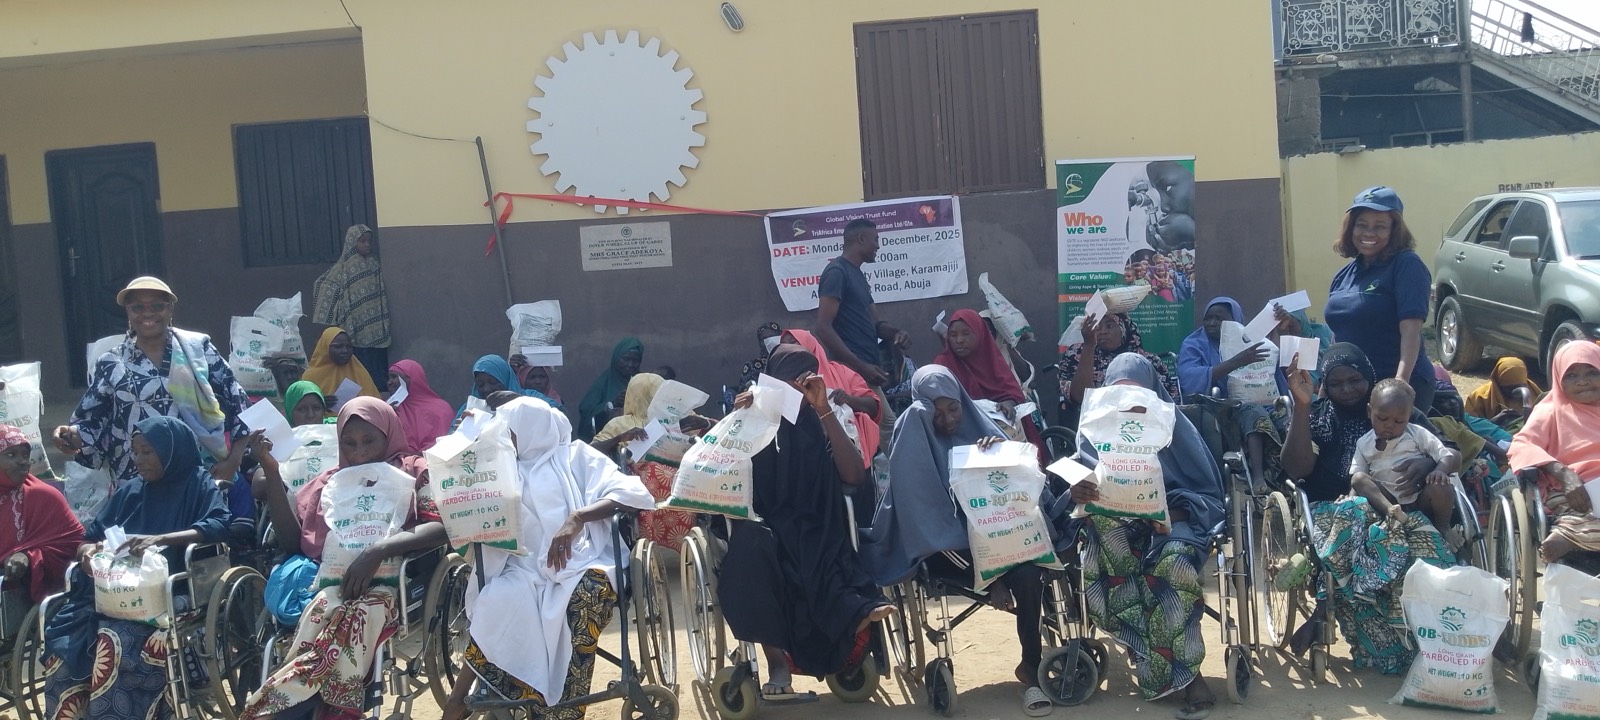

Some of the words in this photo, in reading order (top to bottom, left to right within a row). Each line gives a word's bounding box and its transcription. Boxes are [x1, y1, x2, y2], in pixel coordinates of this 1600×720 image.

[825, 215, 844, 223] Global
[1064, 212, 1103, 226] Who
[1066, 227, 1084, 235] we
[1088, 225, 1107, 234] are
[773, 245, 810, 258] DATE:
[812, 242, 845, 254] Monda
[881, 233, 932, 247] December,
[934, 229, 961, 241] 2025
[781, 275, 821, 288] VENUE
[873, 268, 909, 279] Village,
[911, 261, 959, 275] Karamajiji
[874, 281, 902, 293] Road,
[904, 278, 931, 290] Abuja
[440, 470, 498, 492] QB-FOODS
[1143, 477, 1153, 485] KG
[441, 493, 482, 507] PARBOILED
[485, 490, 504, 500] RICE
[453, 488, 469, 497] LONG
[969, 491, 1032, 509] QB-FOODS
[477, 507, 486, 515] 10
[487, 505, 500, 513] KG
[987, 531, 996, 539] NET
[1024, 521, 1034, 530] KG
[1416, 626, 1491, 648] QB-FOODS
[1421, 650, 1469, 666] PARBOILED
[1438, 647, 1453, 657] LONG
[1428, 668, 1437, 676] NET
[1461, 672, 1470, 680] 10
[1472, 672, 1483, 680] KG
